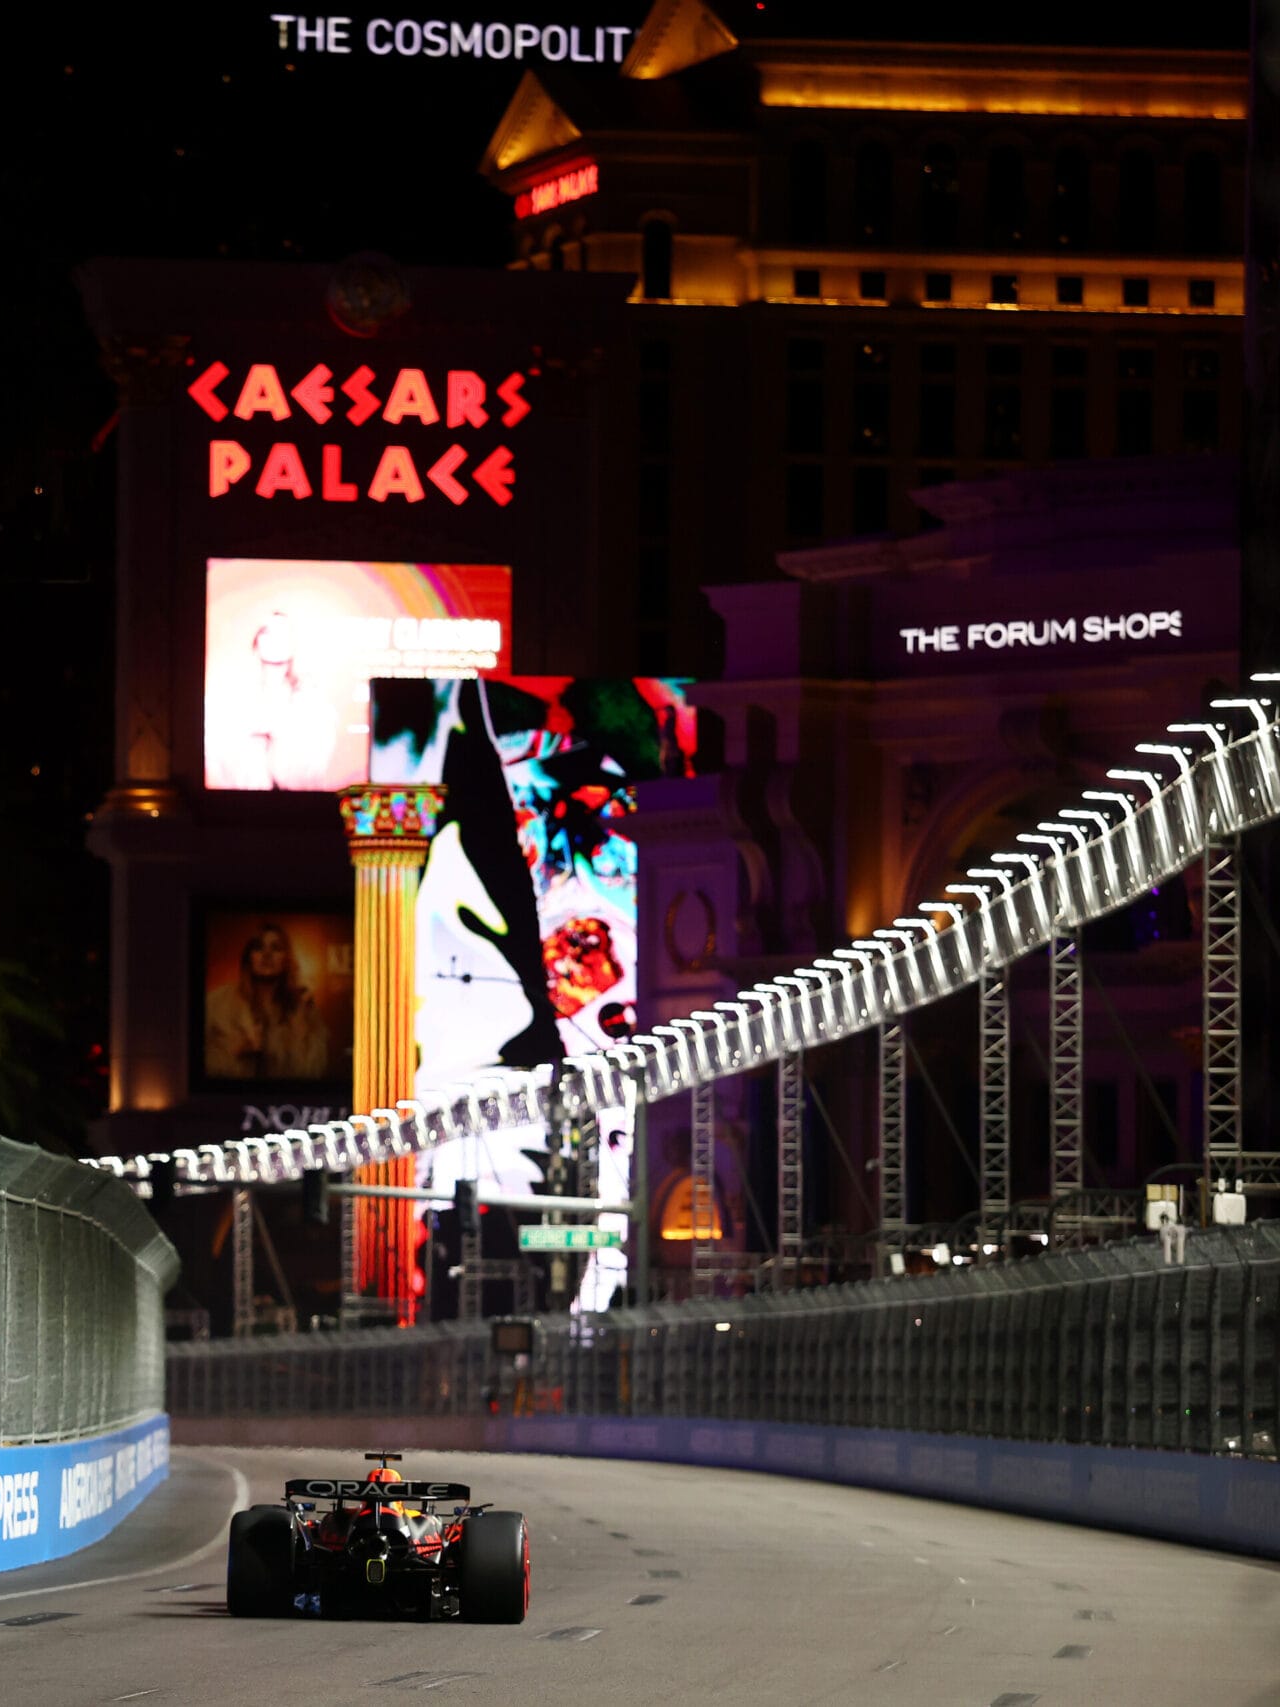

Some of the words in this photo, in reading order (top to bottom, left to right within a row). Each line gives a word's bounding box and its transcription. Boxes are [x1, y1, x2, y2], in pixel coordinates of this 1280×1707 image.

[270, 14, 352, 54] THE
[365, 18, 634, 63] COSMOPOLIT
[187, 360, 531, 428] CAESARS
[209, 440, 516, 507] PALACE
[899, 625, 961, 654] THE
[966, 617, 1078, 650] FORUM
[1081, 609, 1183, 643] SHOPS
[306, 1480, 449, 1498] ORACLE
